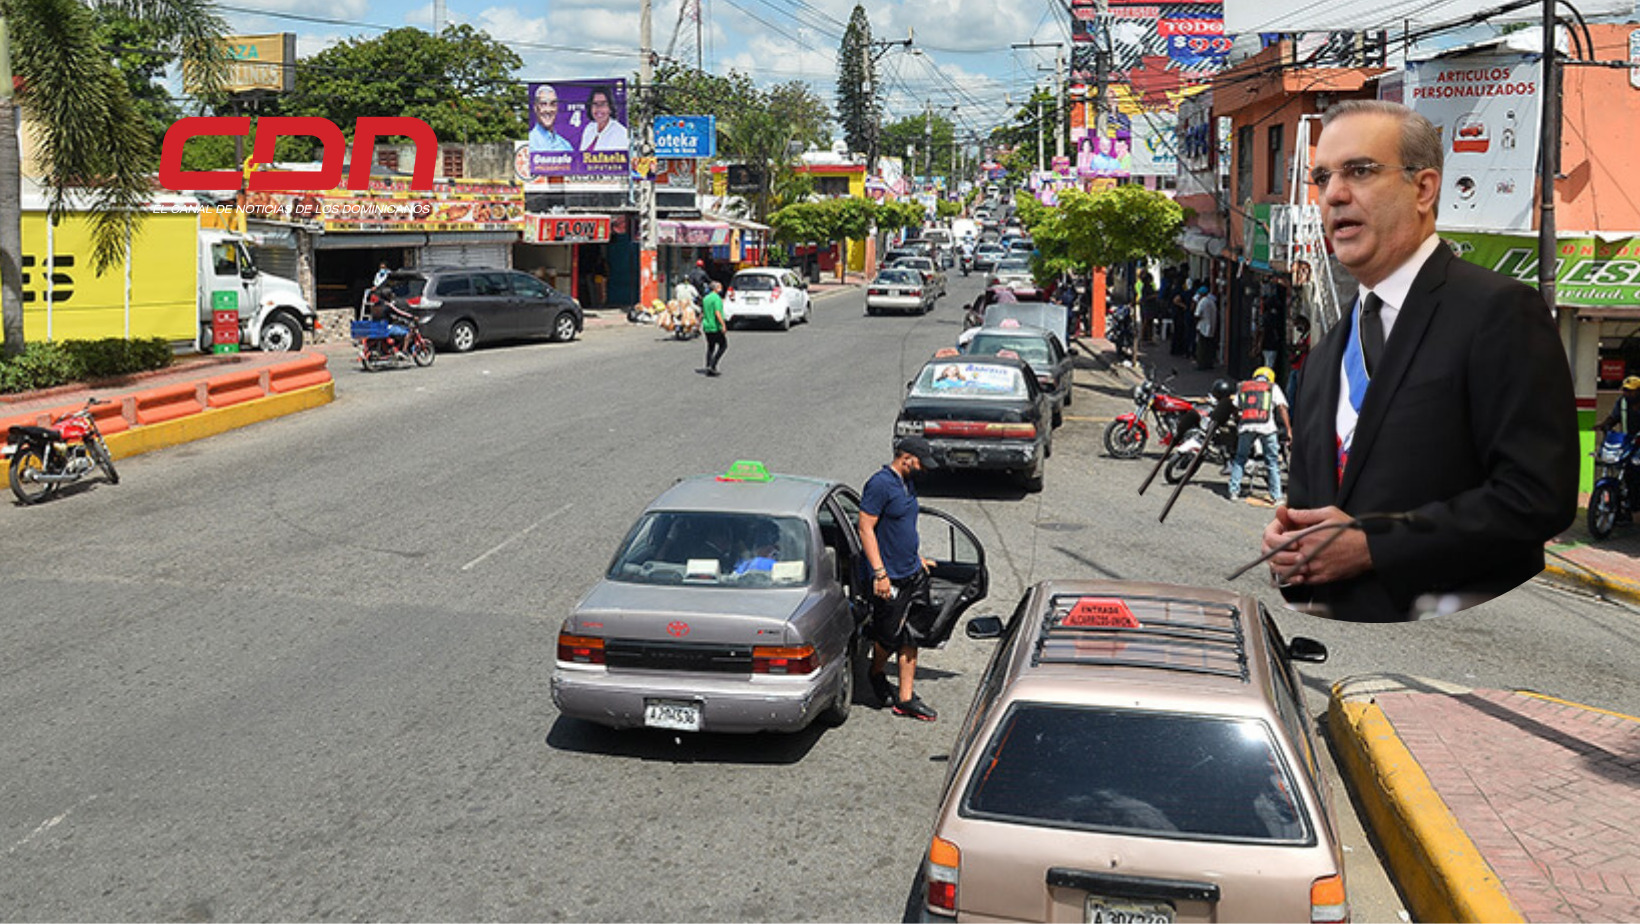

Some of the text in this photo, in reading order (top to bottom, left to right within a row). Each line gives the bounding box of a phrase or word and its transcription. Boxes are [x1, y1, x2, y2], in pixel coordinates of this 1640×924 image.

[1164, 21, 1224, 32] TODO
[1436, 67, 1511, 82] ARTICULOS
[1413, 82, 1536, 99] PERSONALIZADOS
[569, 110, 582, 128] 4
[655, 132, 699, 147] oteka
[583, 152, 627, 164] Rafaela
[555, 221, 596, 237] FLOW
[1559, 259, 1640, 286] ES
